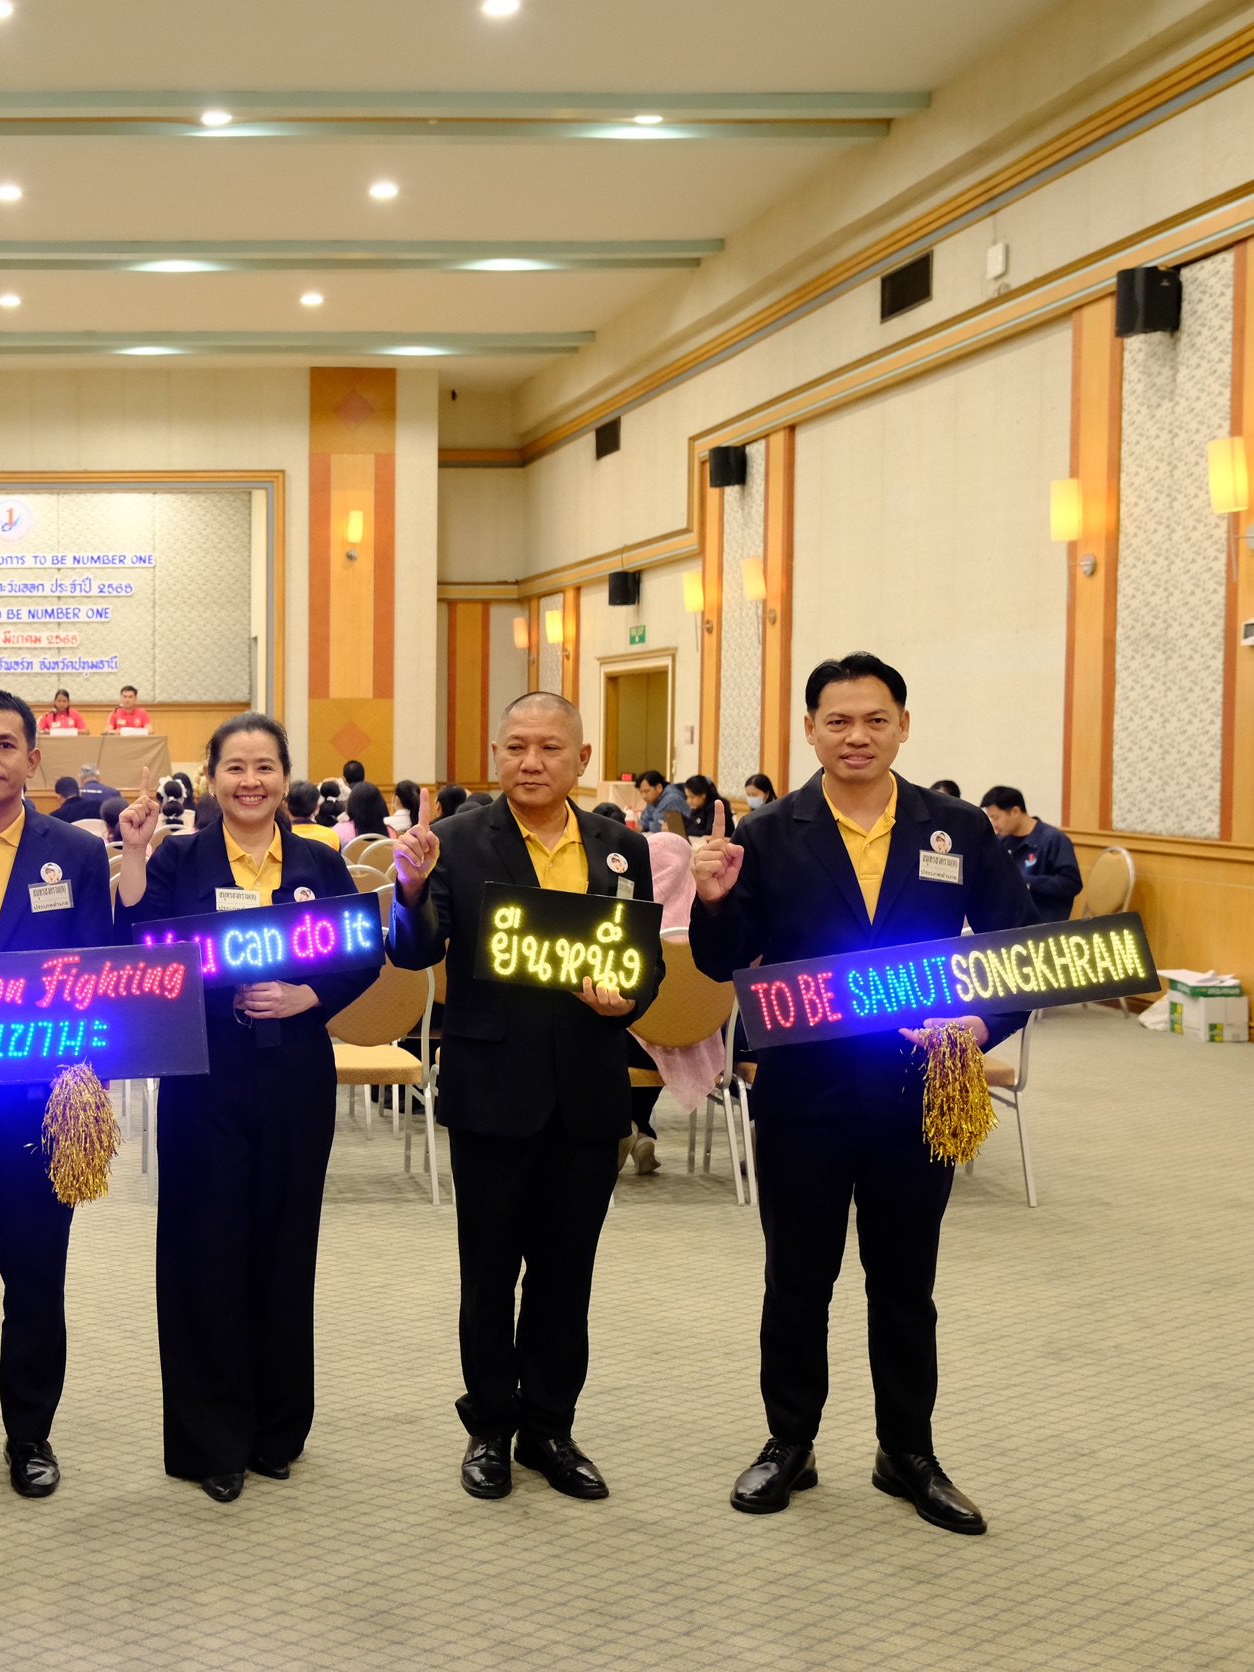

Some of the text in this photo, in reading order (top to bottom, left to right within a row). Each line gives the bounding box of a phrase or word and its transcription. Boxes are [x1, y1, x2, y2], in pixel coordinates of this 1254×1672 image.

[32, 555, 47, 566] TO
[51, 555, 68, 565] BE
[72, 555, 127, 565] NUMBER
[131, 554, 154, 565] ONE
[50, 576, 92, 594] ประจำปี
[97, 583, 134, 594] 2568
[6, 608, 23, 620] BE
[27, 607, 81, 620] NUMBER
[86, 607, 111, 619] ONE
[2, 630, 42, 645] มีนาคม
[223, 928, 284, 967] can
[292, 914, 336, 958] do
[342, 910, 371, 951] it
[34, 954, 187, 1012] Fighting
[750, 980, 797, 1032] TO
[797, 971, 843, 1027] BE
